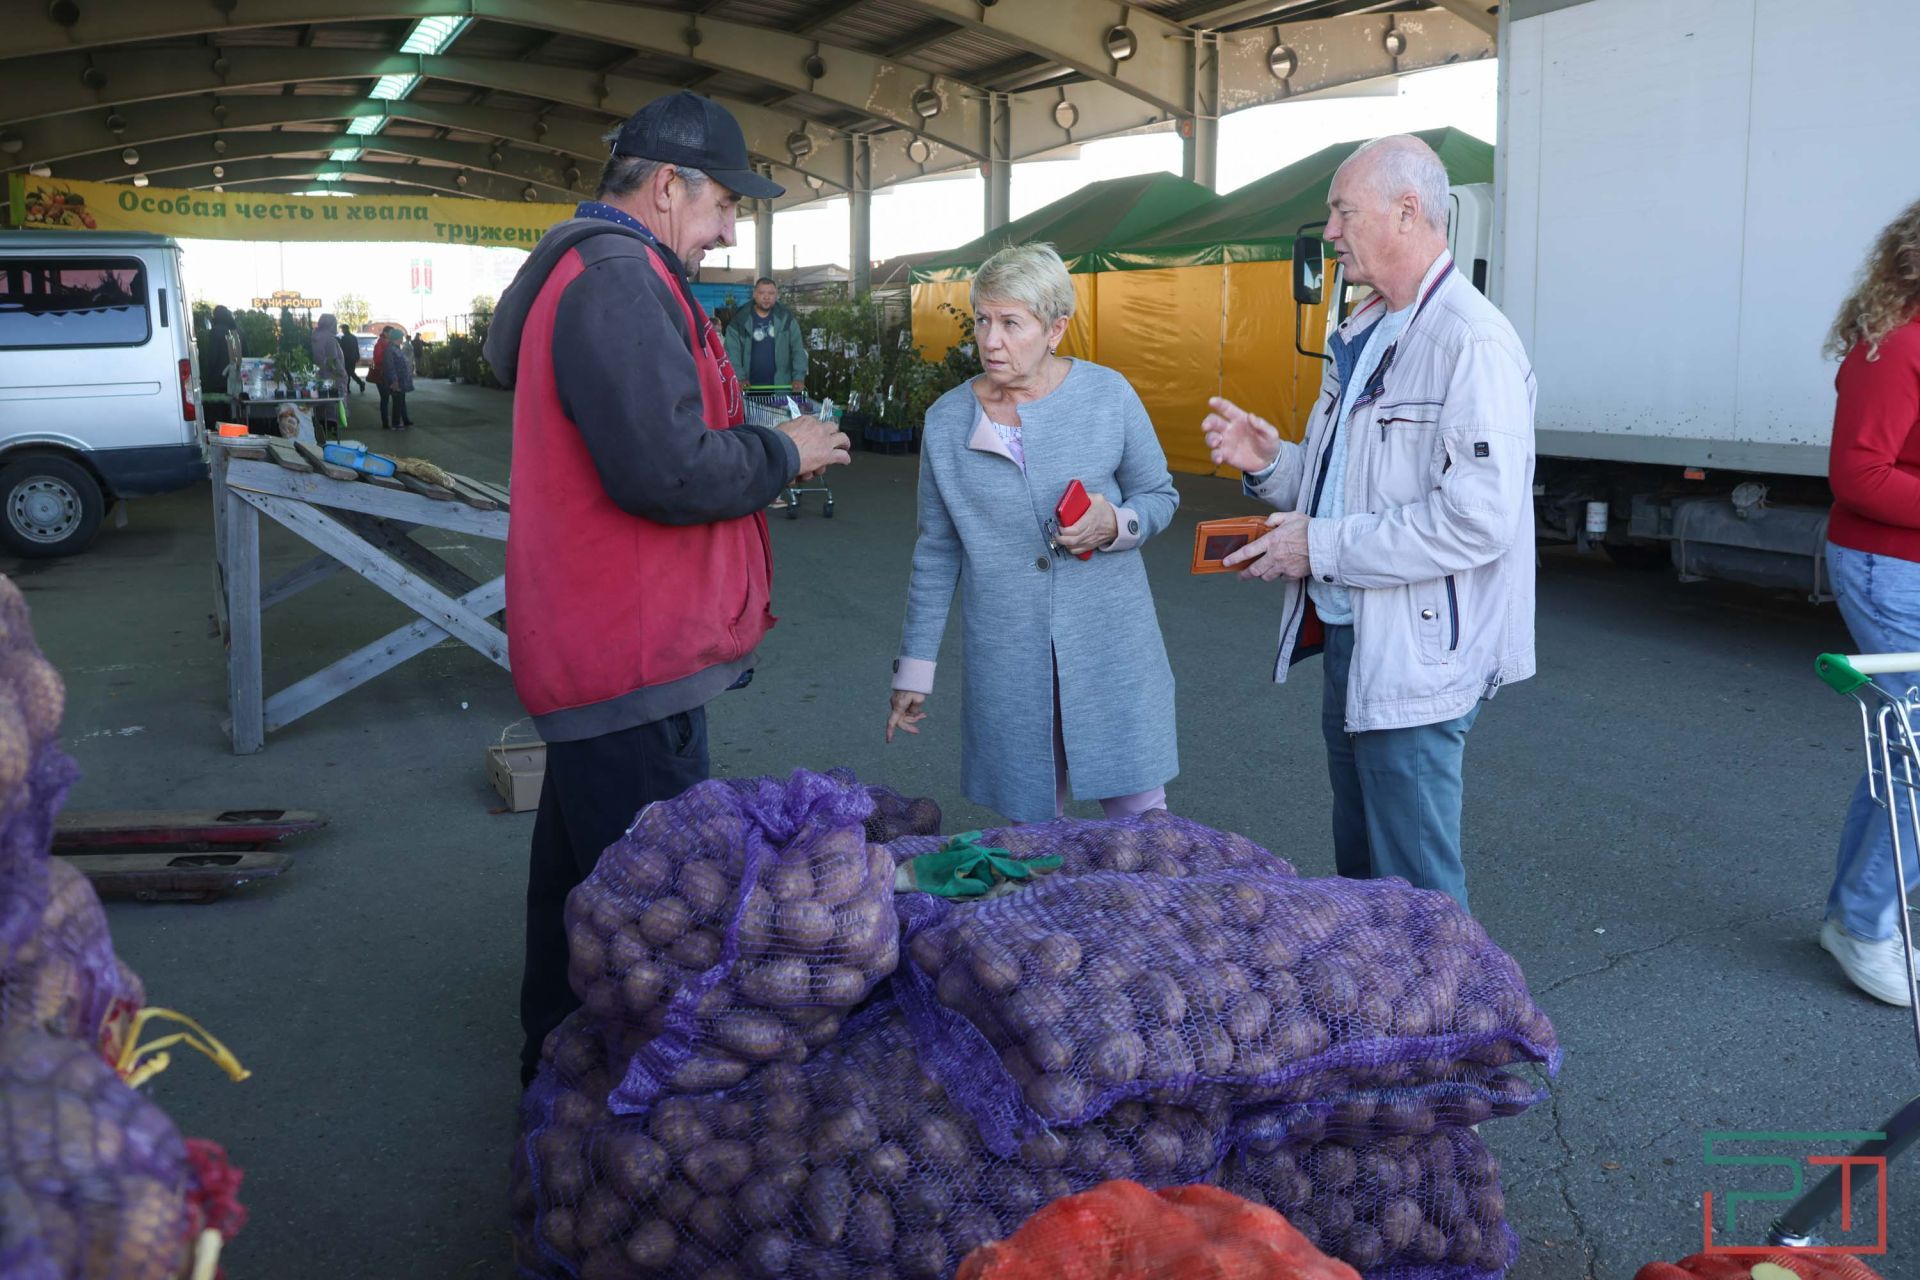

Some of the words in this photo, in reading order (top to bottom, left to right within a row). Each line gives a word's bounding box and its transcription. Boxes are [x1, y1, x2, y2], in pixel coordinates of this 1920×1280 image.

[118, 190, 226, 218] Особая
[235, 203, 313, 220] честь
[322, 204, 339, 220] и
[346, 205, 429, 221] хвала
